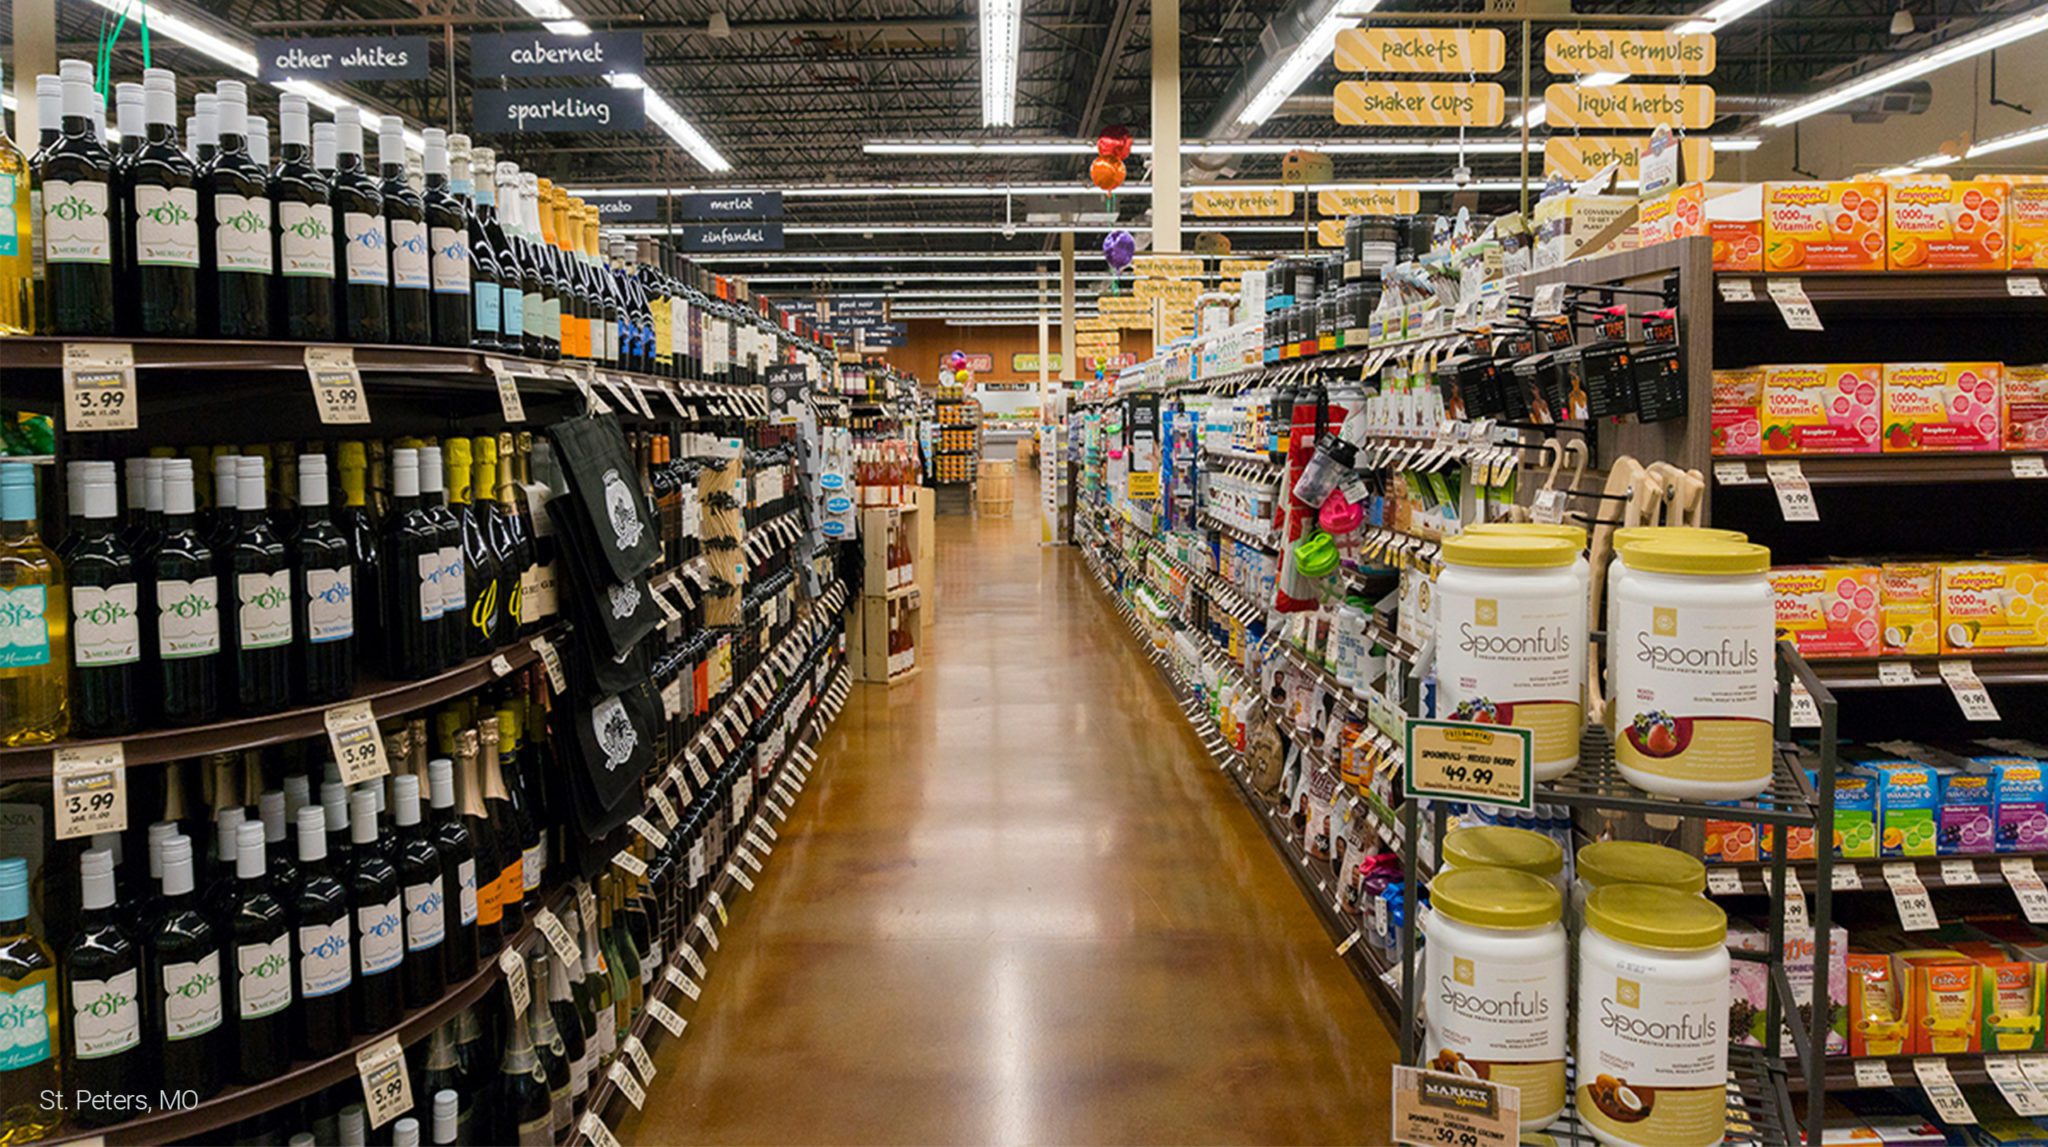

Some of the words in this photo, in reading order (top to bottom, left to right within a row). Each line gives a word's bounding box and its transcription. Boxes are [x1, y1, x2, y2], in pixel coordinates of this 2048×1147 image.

[276, 48, 332, 69] other
[341, 47, 408, 67] whites
[511, 40, 603, 64] cabernet
[1382, 38, 1458, 63] packets
[1557, 40, 1613, 59] herbal
[1620, 40, 1704, 61] formulas
[1364, 92, 1424, 111] shaker
[1431, 95, 1473, 115] cups
[1577, 94, 1627, 117] liquid
[1633, 95, 1684, 114] herbs
[508, 99, 610, 129] sparkling
[1582, 148, 1639, 166] herbal
[600, 200, 632, 213] scato
[710, 197, 753, 210] merlot
[1342, 194, 1395, 208] superfood
[1772, 221, 1814, 231] Vitamin
[1815, 221, 1822, 231] C
[1895, 220, 1936, 230] Vitamin
[1937, 220, 1944, 230] C
[702, 228, 764, 245] zinfandel
[1769, 405, 1810, 415] Vitamin
[1811, 405, 1819, 415] C
[1890, 404, 1930, 413] Vitamin
[1932, 403, 1939, 413] C
[1776, 600, 1795, 609] 000
[1948, 605, 1989, 615] Vitamin
[1990, 605, 1997, 615] C
[1776, 610, 1810, 619] itamin
[1811, 610, 1818, 619] C
[1460, 622, 1569, 658] Spoonfuls
[1637, 631, 1758, 669] Spoonfuls
[1441, 975, 1549, 1017] Spoonfuls
[1600, 997, 1716, 1041] Spoonfuls
[1425, 1083, 1488, 1101] MARKET
